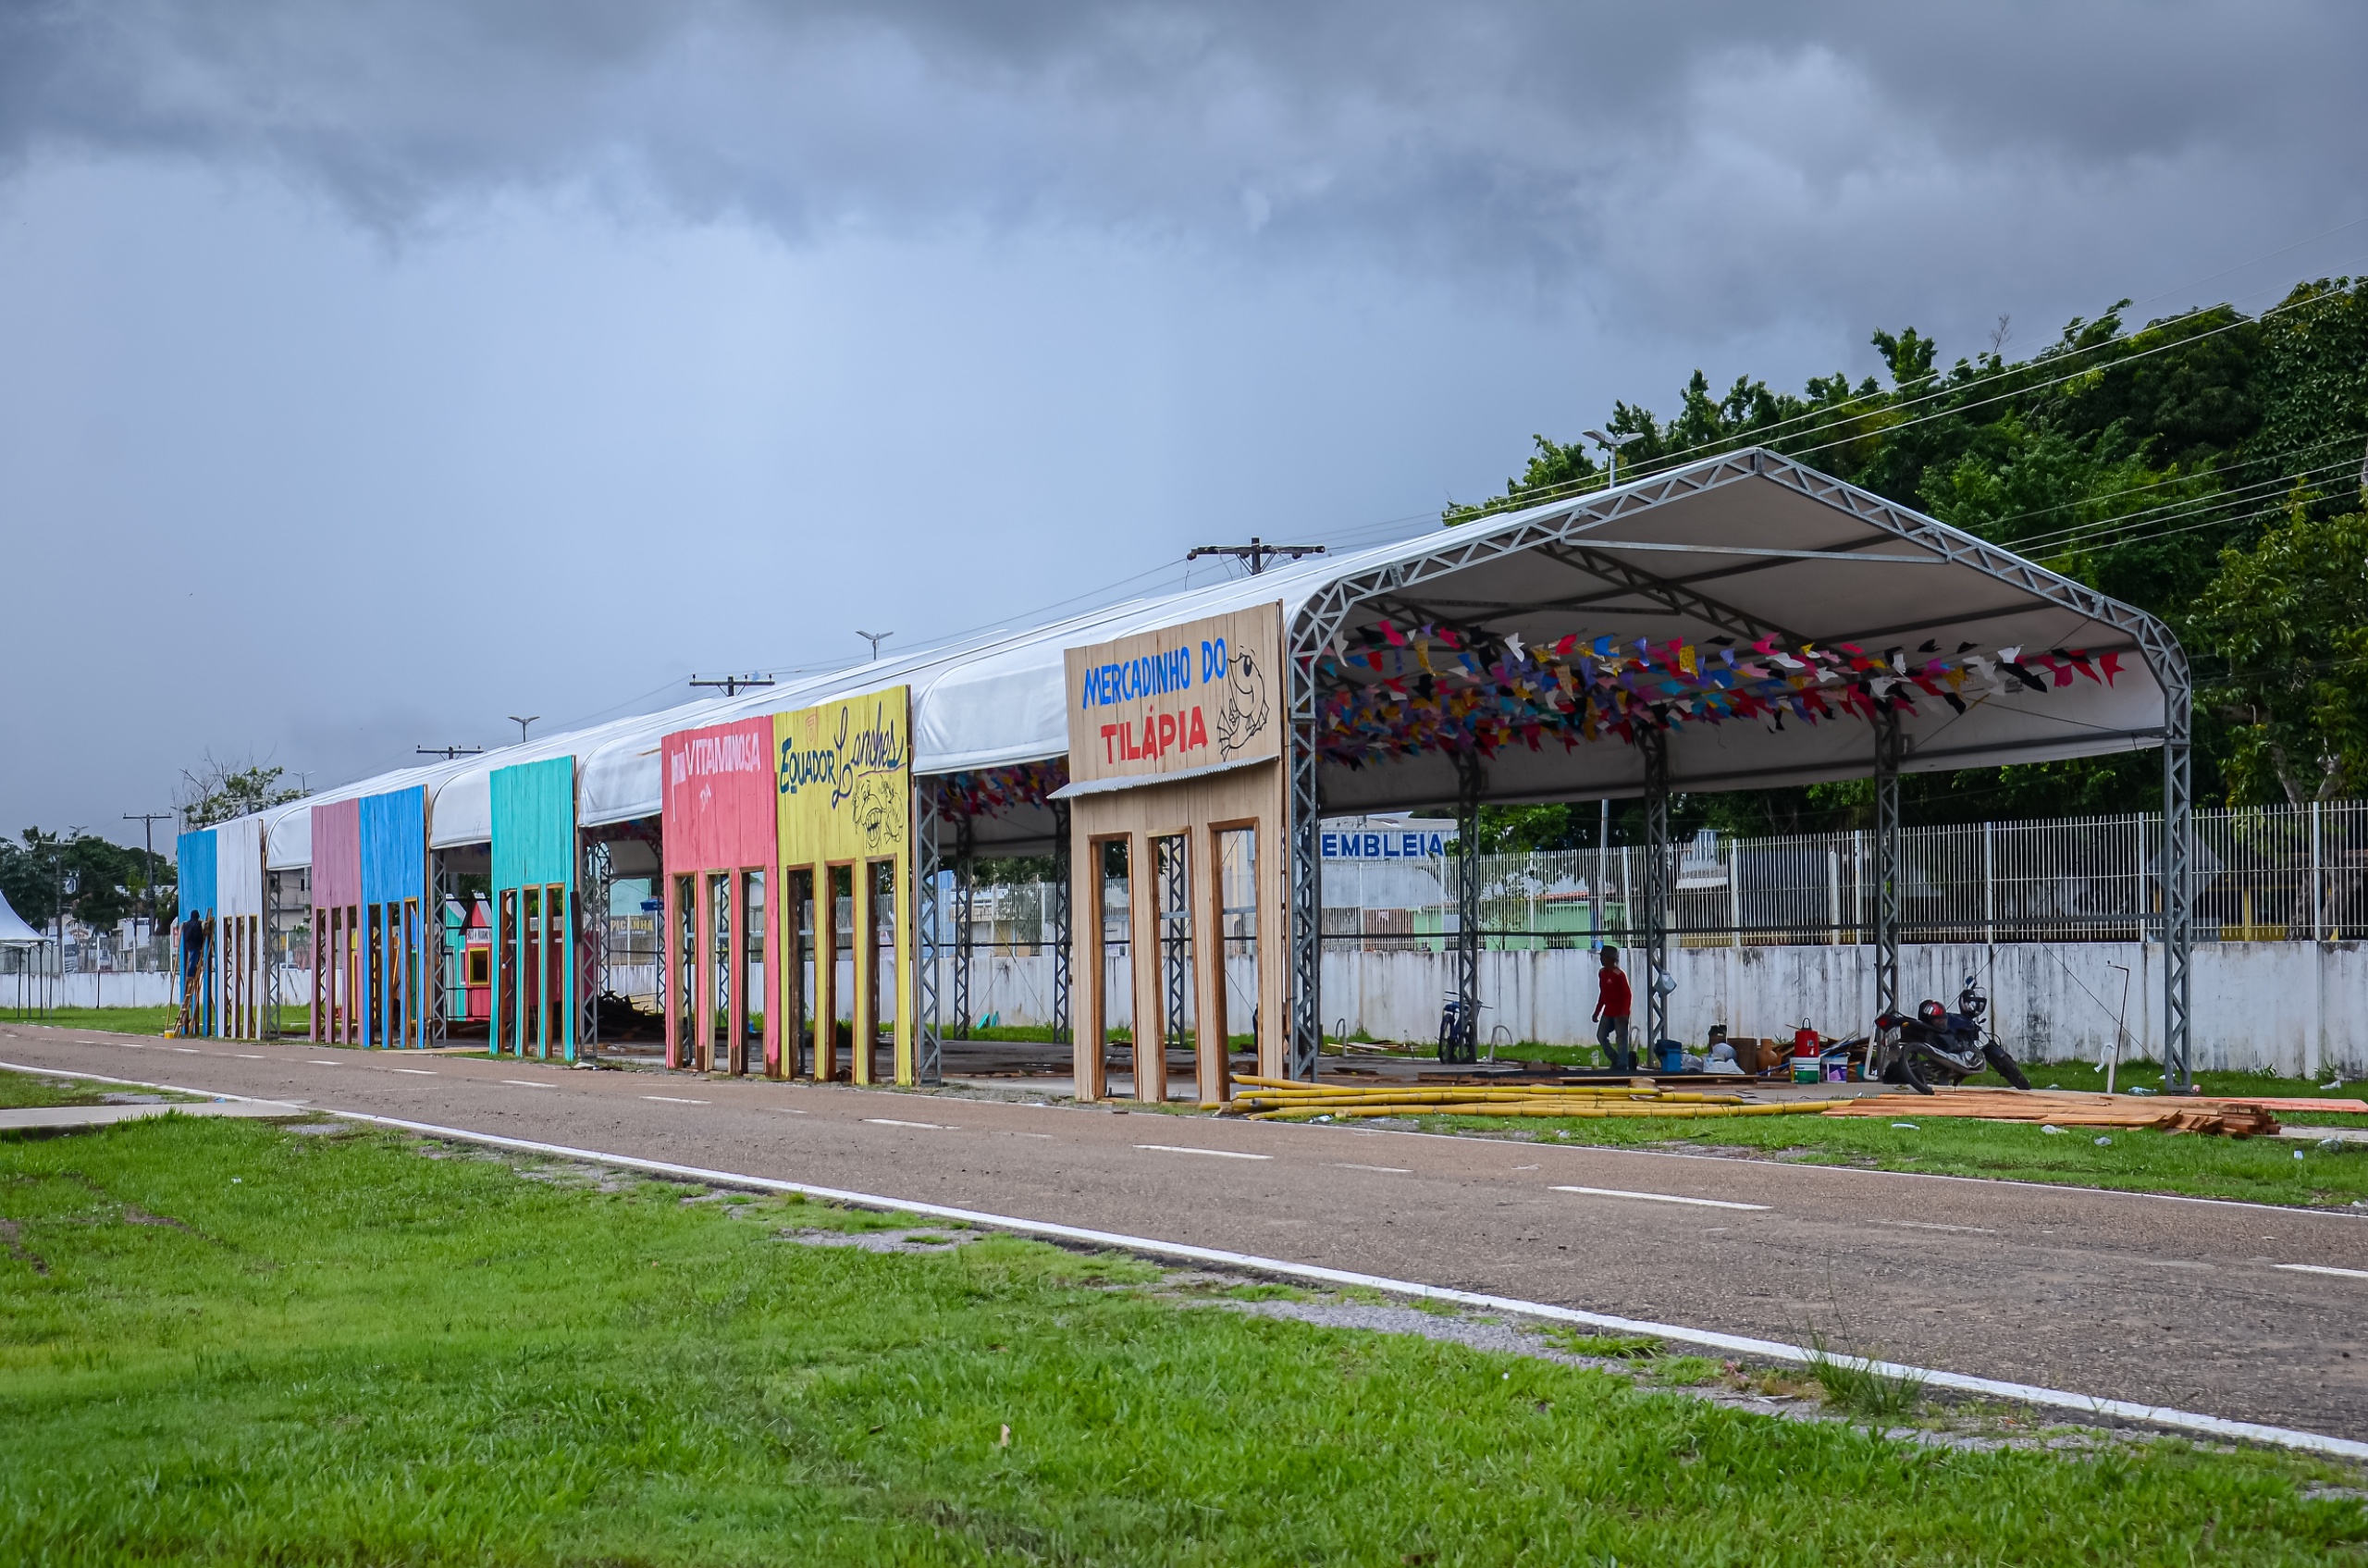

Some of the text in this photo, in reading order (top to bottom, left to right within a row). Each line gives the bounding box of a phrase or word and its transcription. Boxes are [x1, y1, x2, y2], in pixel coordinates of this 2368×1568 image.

[1082, 637, 1227, 710] MERCADINHO DO
[684, 732, 760, 775] VITAMINOSA
[832, 700, 905, 810] Lanches
[1101, 704, 1208, 764] TILÁPIA
